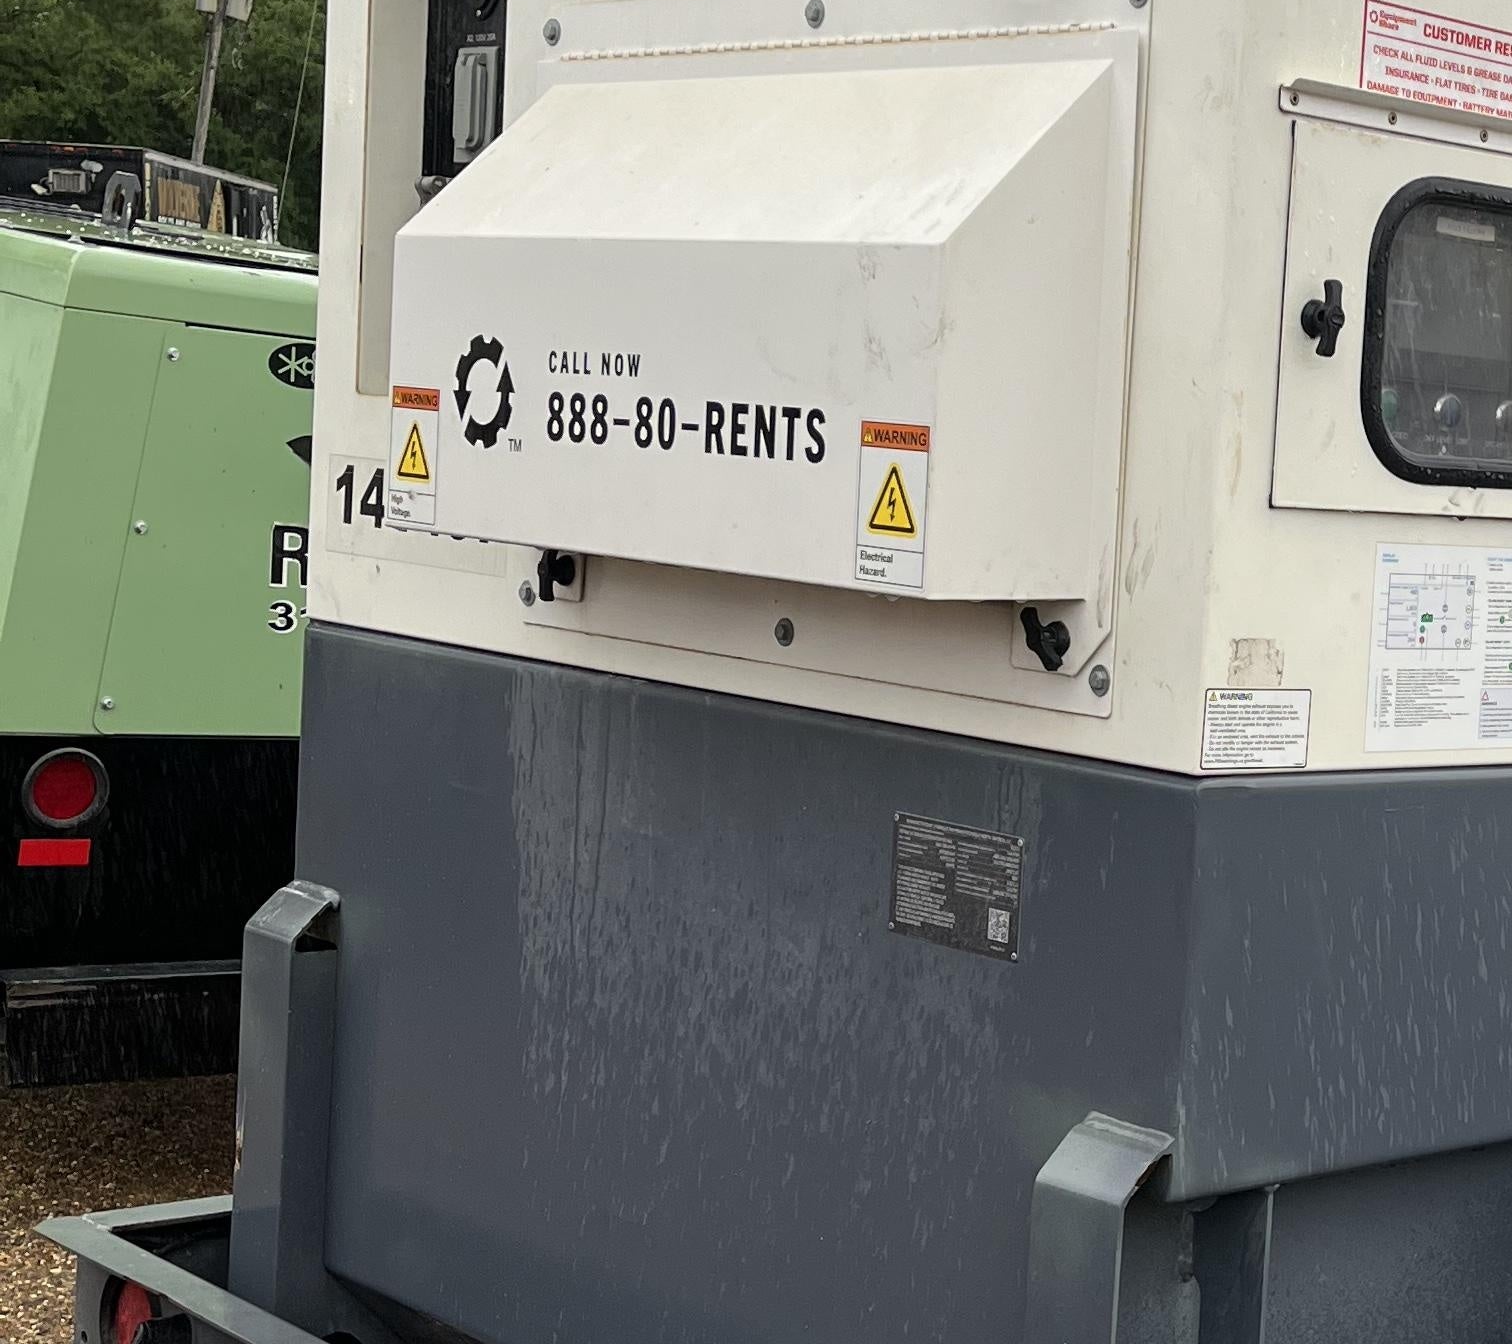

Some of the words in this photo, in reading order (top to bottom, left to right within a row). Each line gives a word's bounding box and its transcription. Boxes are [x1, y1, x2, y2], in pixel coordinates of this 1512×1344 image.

[1423, 23, 1492, 52] CUSTOMER
[1373, 44, 1399, 59] CHECK
[1401, 50, 1414, 63] ALL
[1415, 54, 1438, 67] FLUID
[1439, 58, 1465, 74] LEVELS
[1474, 67, 1501, 82] GREASE
[1366, 80, 1399, 96] DAMAGE
[1401, 87, 1412, 98] TO
[1385, 65, 1430, 84] INSURANCE
[1434, 76, 1452, 89] FLAT
[1454, 81, 1477, 94] TIRES
[1481, 87, 1498, 99] TIRE
[549, 350, 592, 376] CALL
[601, 352, 641, 378] NOW
[401, 393, 438, 408] WARNING
[547, 391, 827, 464] 888-80-RENTS
[508, 438, 522, 453] TM
[873, 428, 927, 447] WARNING
[860, 550, 894, 564] Electrical
[859, 564, 887, 578] Hazard.
[1220, 692, 1253, 701] WARNING
